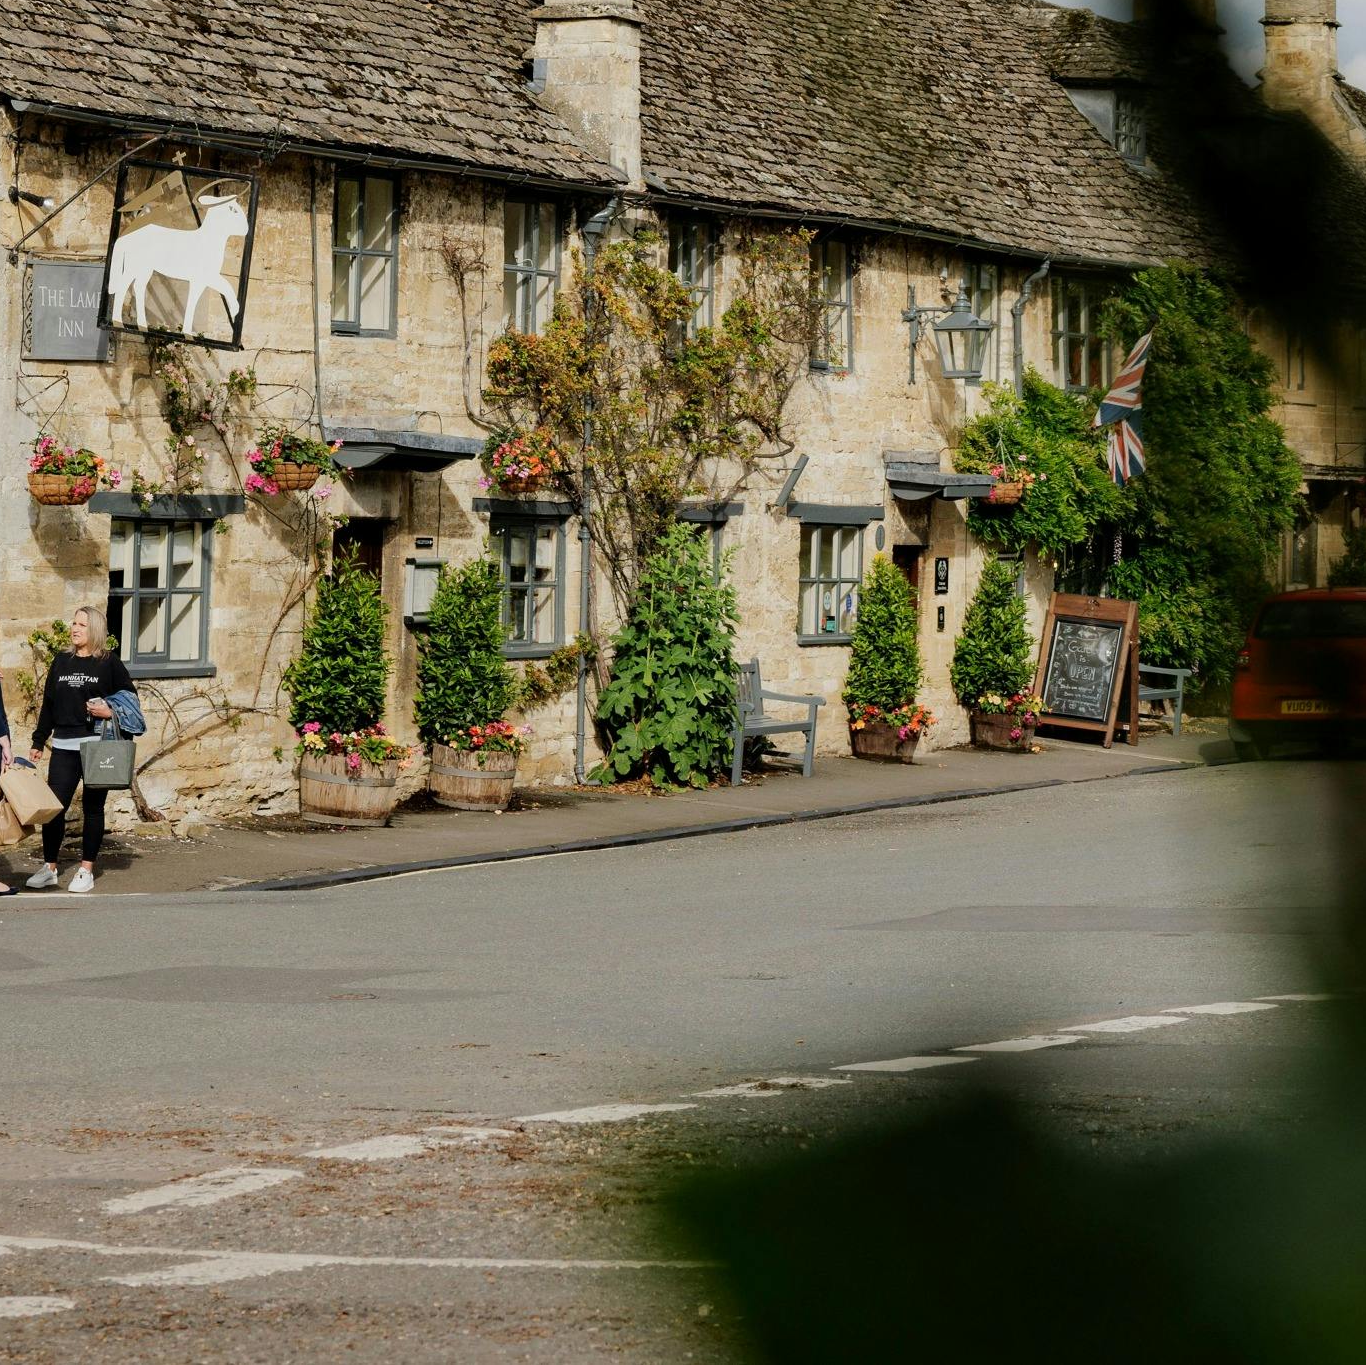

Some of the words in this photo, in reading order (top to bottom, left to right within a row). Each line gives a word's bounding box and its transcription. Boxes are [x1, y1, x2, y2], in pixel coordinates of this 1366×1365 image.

[38, 285, 65, 307] THE
[58, 317, 84, 337] INN
[58, 675, 99, 684] MANHATTAN
